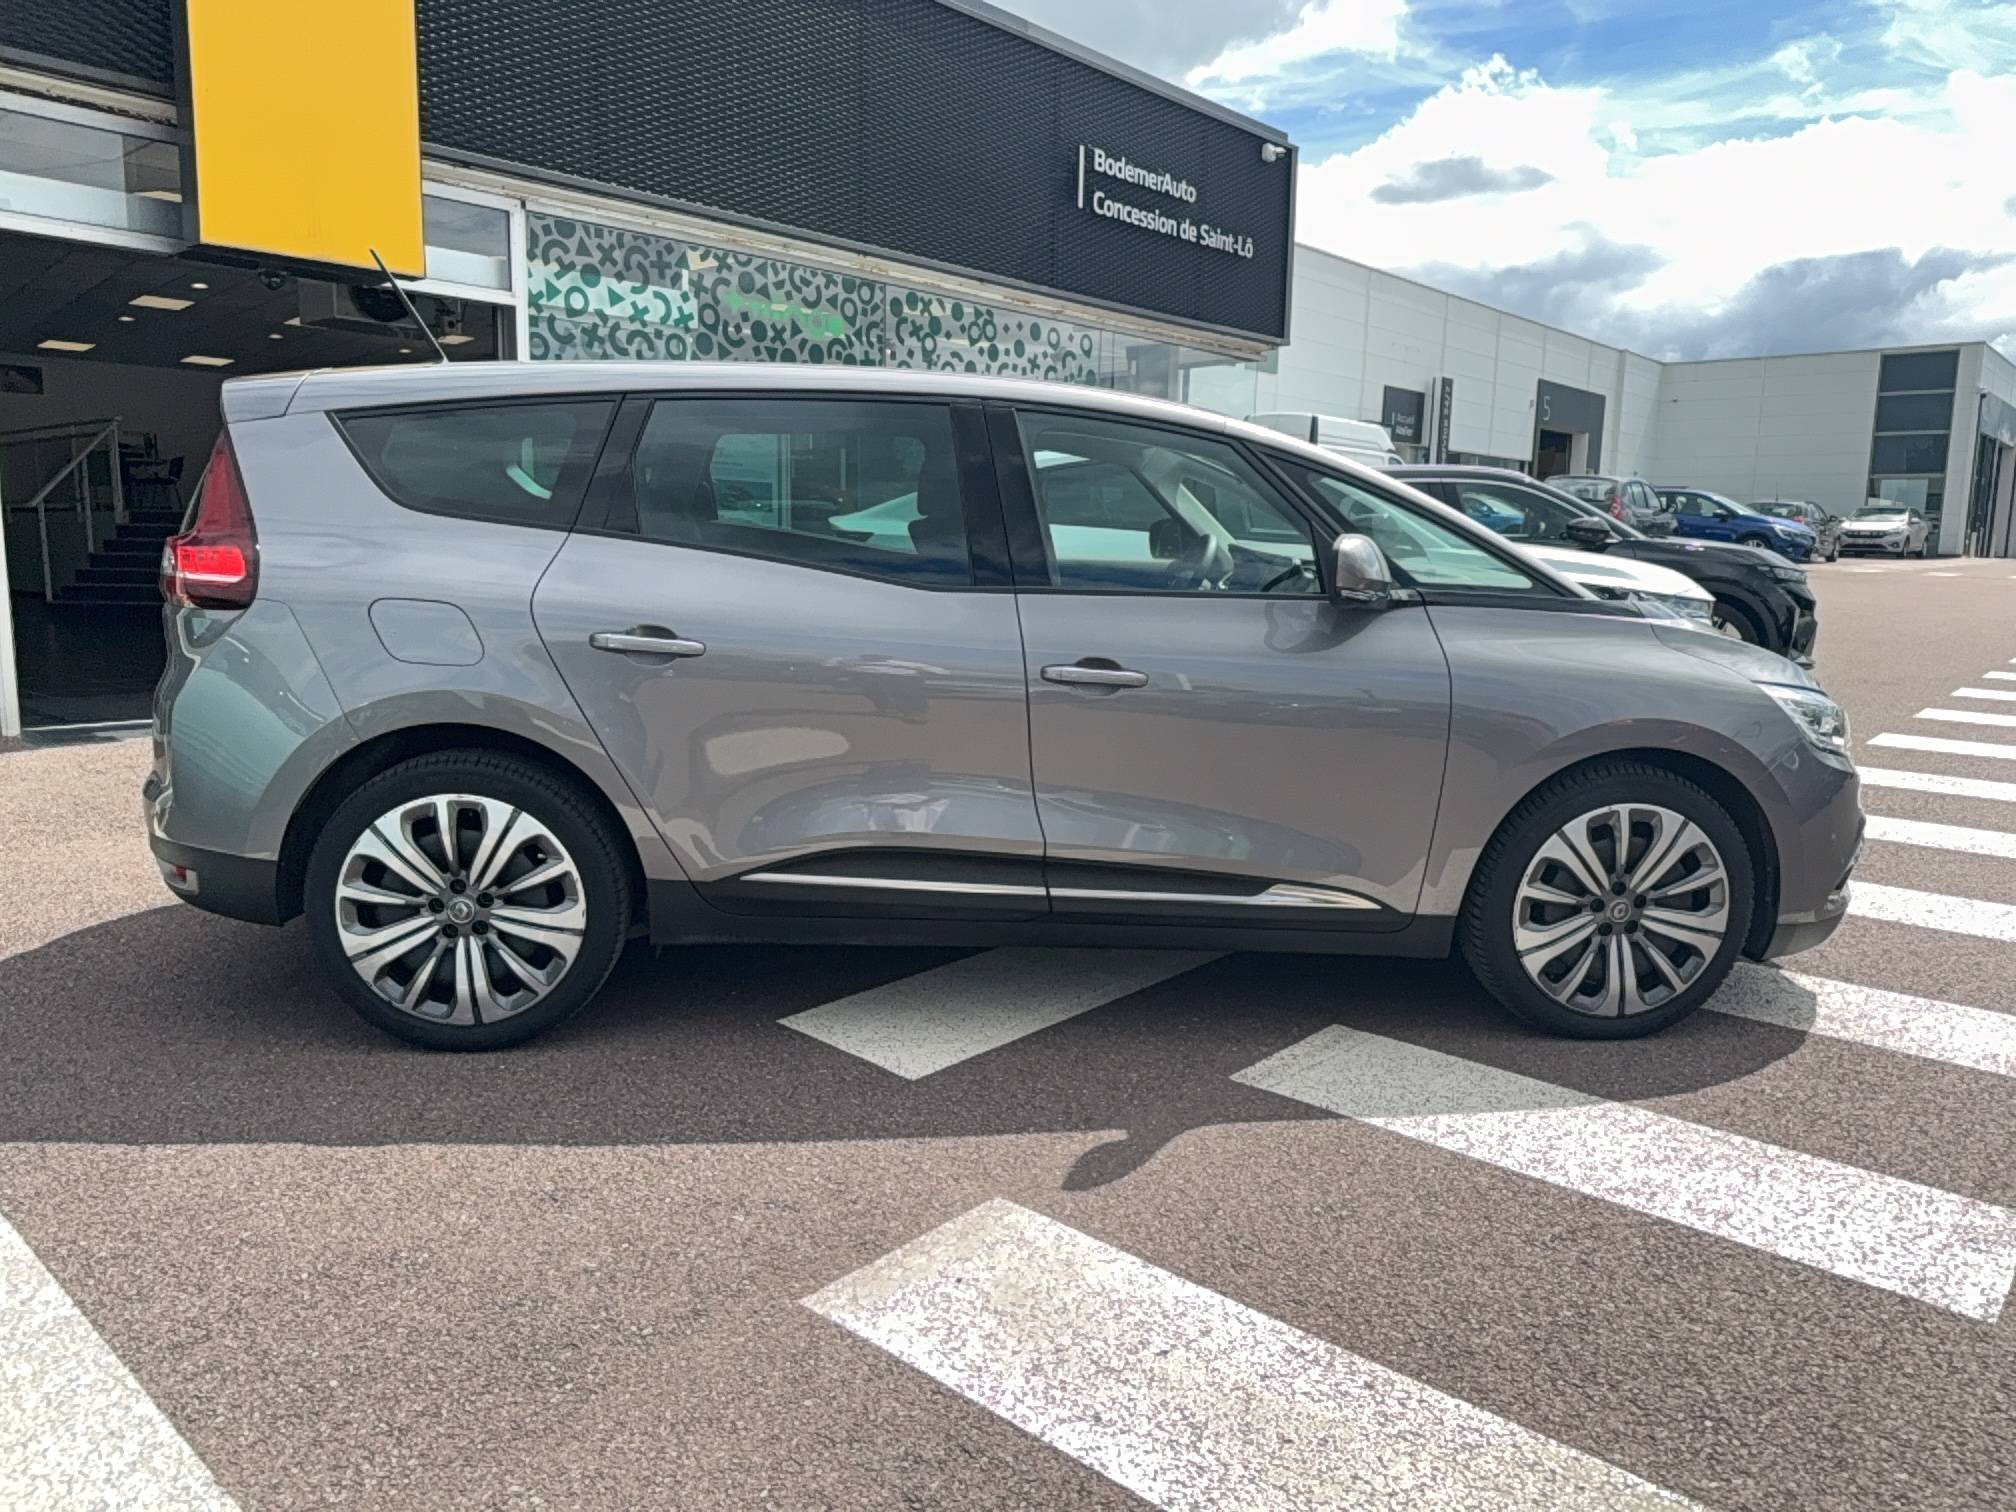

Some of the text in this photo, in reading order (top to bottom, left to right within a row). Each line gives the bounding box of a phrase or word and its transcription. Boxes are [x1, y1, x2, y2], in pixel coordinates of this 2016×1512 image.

[1093, 148, 1197, 203] BodemerAuto
[1093, 190, 1254, 259] Concession de Saint-Lô
